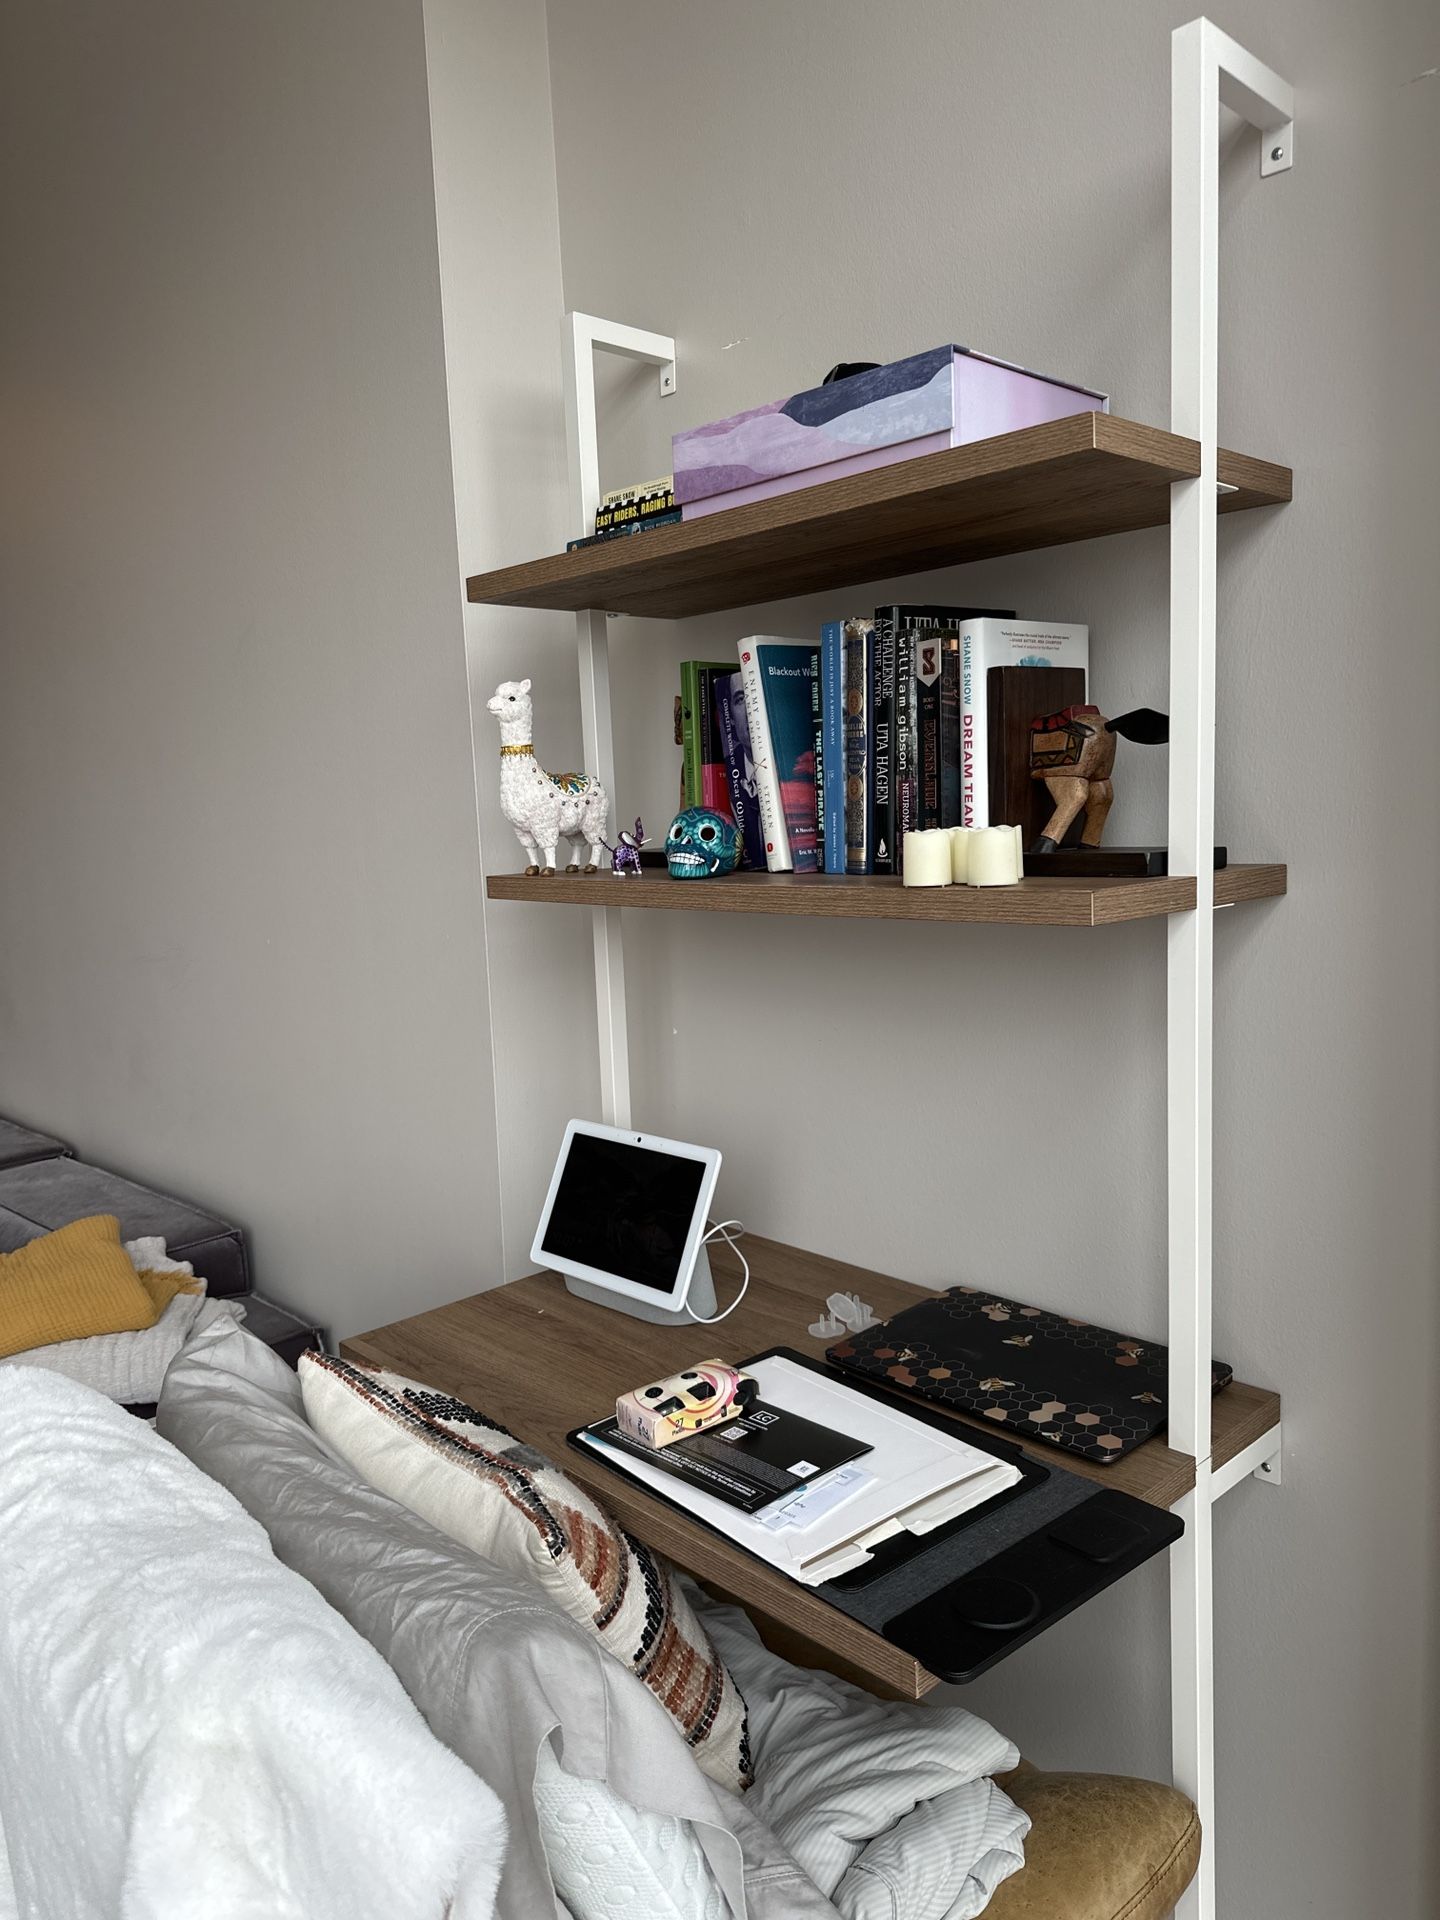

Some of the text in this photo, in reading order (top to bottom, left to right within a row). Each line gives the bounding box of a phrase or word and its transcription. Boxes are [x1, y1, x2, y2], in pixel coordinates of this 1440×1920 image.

[596, 514, 612, 527] EASY
[613, 507, 639, 522] RIDERS,
[641, 498, 666, 515] RAGING
[622, 491, 635, 499] SNOW
[768, 666, 800, 676] Blackout
[882, 618, 893, 698] A CHALLENGE
[723, 698, 731, 733] COMPLETE
[744, 682, 755, 743] MANKIND
[749, 670, 759, 712] ENEMY
[756, 721, 760, 730] OF
[898, 638, 908, 770] william gibson
[876, 723, 888, 805] UTA HAGEN
[964, 715, 973, 828] DREAM TEAM
[732, 768, 745, 833] Oscar Wilde
[756, 783, 767, 834] JOHNSON
[764, 786, 773, 828] STEVEN
[675, 1418, 684, 1428] 27
